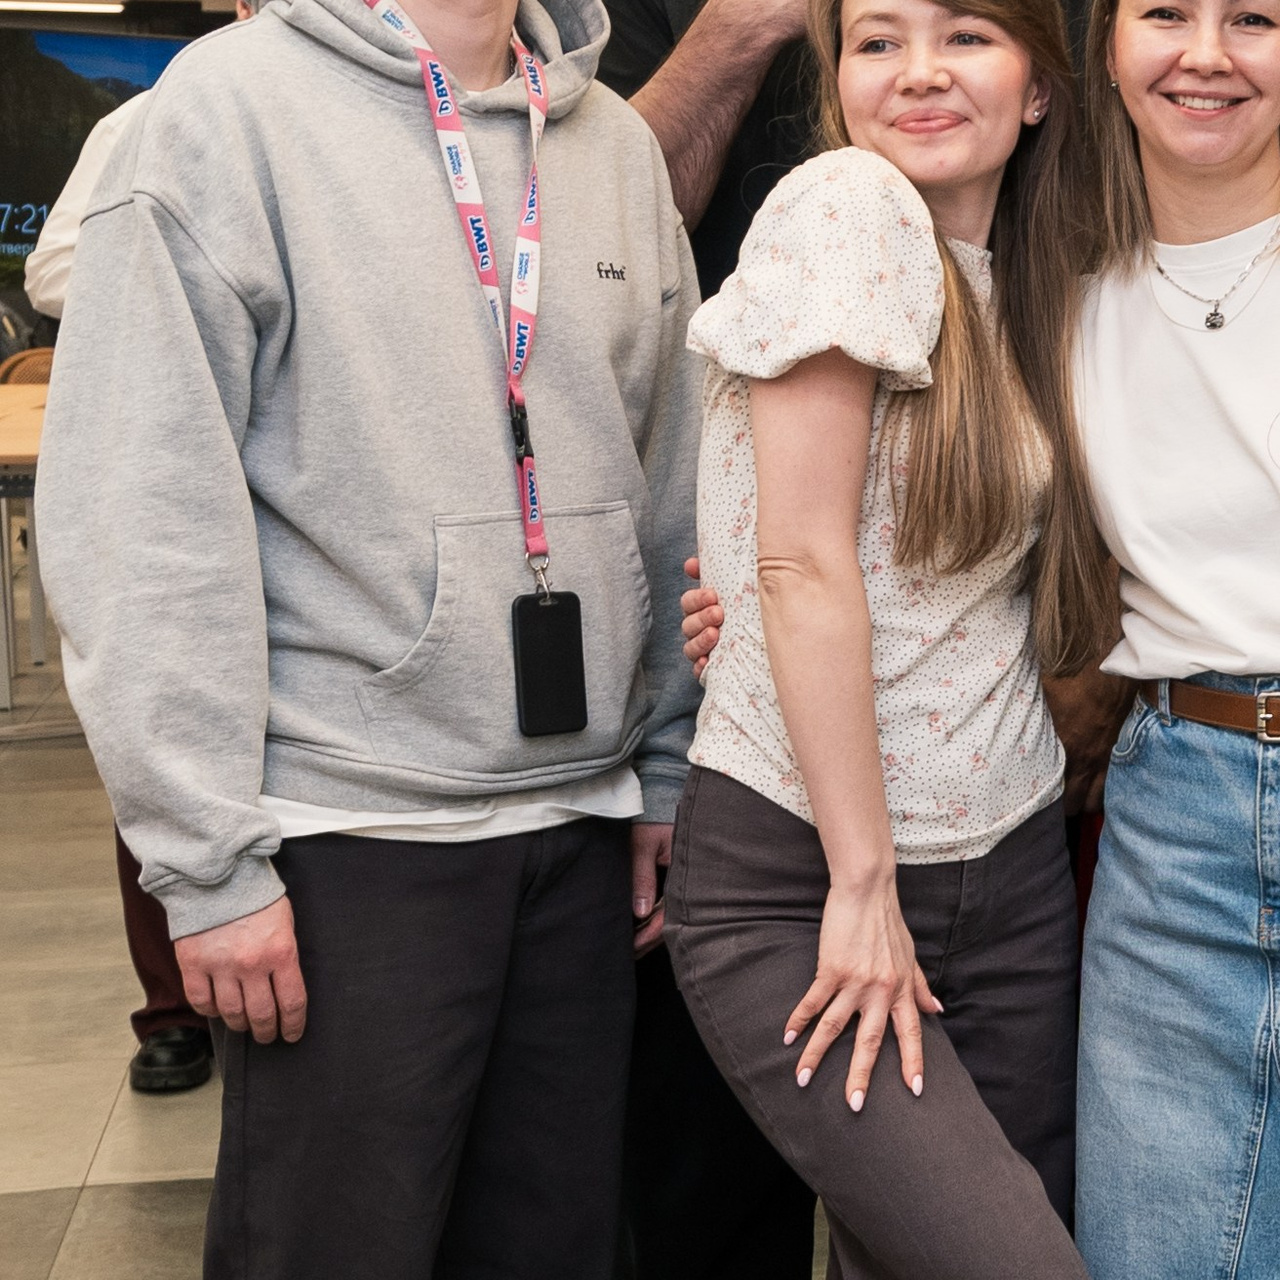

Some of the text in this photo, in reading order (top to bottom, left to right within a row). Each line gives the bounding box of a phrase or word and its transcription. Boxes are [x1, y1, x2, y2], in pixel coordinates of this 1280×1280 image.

[428, 61, 449, 99] BWT
[525, 64, 542, 96] BWT
[470, 217, 489, 253] BWT
[515, 322, 529, 359] BWT
